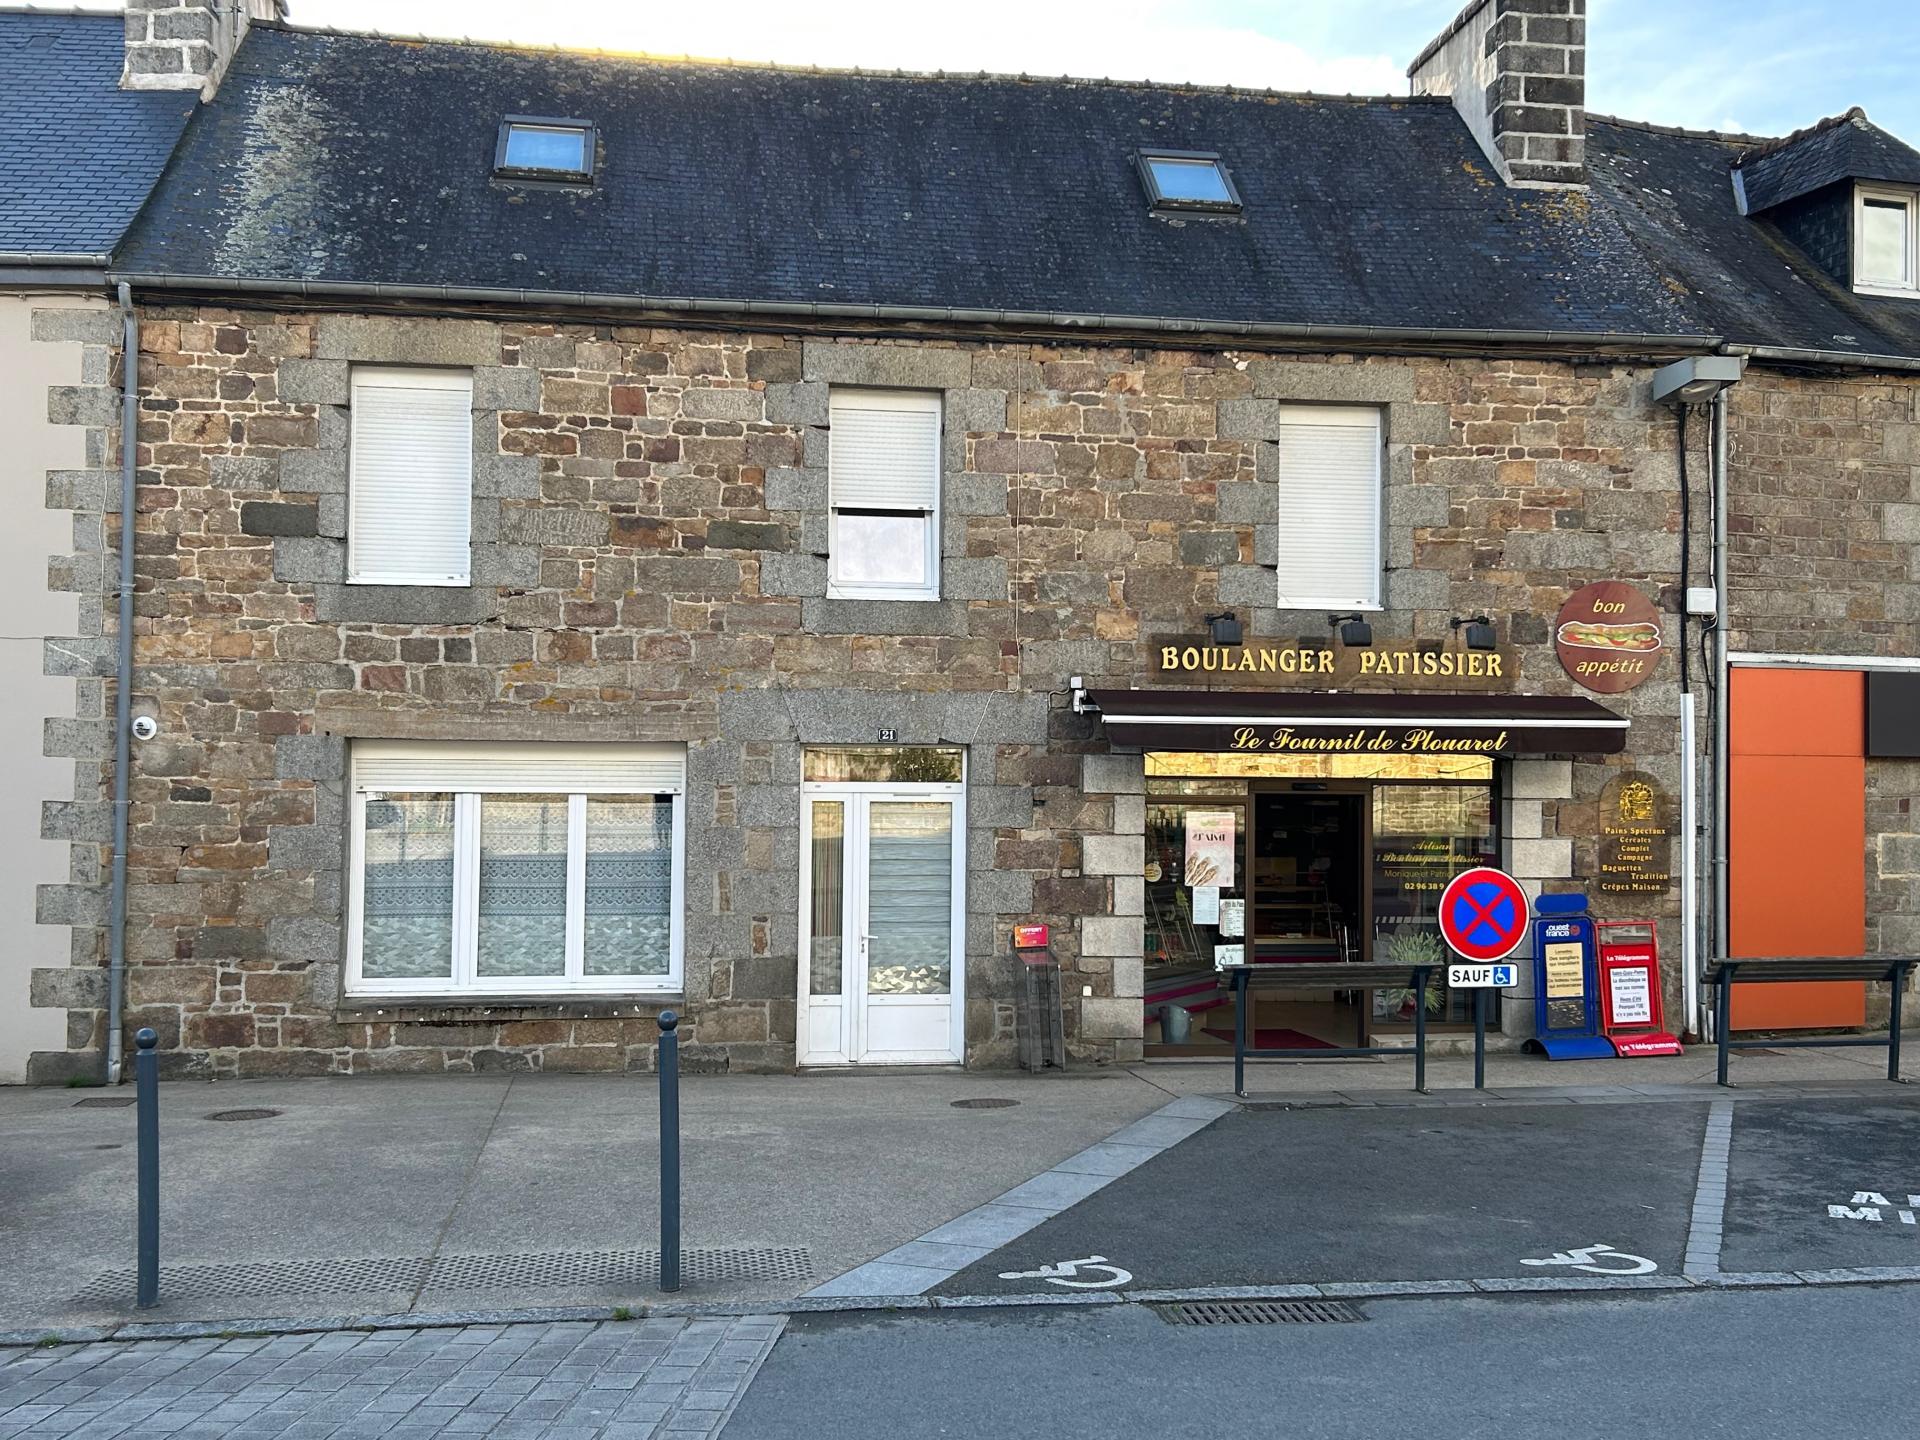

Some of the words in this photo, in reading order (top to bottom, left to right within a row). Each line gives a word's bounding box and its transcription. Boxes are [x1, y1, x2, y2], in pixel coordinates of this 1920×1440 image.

[1593, 598, 1625, 613] bon
[1161, 646, 1335, 673] BOULANGER
[1359, 651, 1502, 677] PATISSIER
[1576, 658, 1644, 677] appétit
[882, 730, 894, 740] 21
[1230, 727, 1265, 749] Le
[1268, 727, 1366, 750] Fournil
[1367, 729, 1398, 750] de
[1401, 728, 1509, 751] Plouaret
[1412, 840, 1453, 851] Artisan
[1617, 854, 1653, 862] Campagne
[1602, 864, 1642, 873] Baguettes
[1384, 869, 1420, 878] Monique
[1631, 872, 1668, 880] Tradition
[1404, 882, 1415, 890] 02
[1416, 882, 1427, 890] 96
[1428, 882, 1438, 890] 38
[1548, 923, 1570, 931] ouest
[1545, 929, 1570, 937] france
[1614, 954, 1650, 962] Télégramme
[1452, 969, 1490, 982] SAUF
[1630, 1042, 1678, 1051] Télégramme
